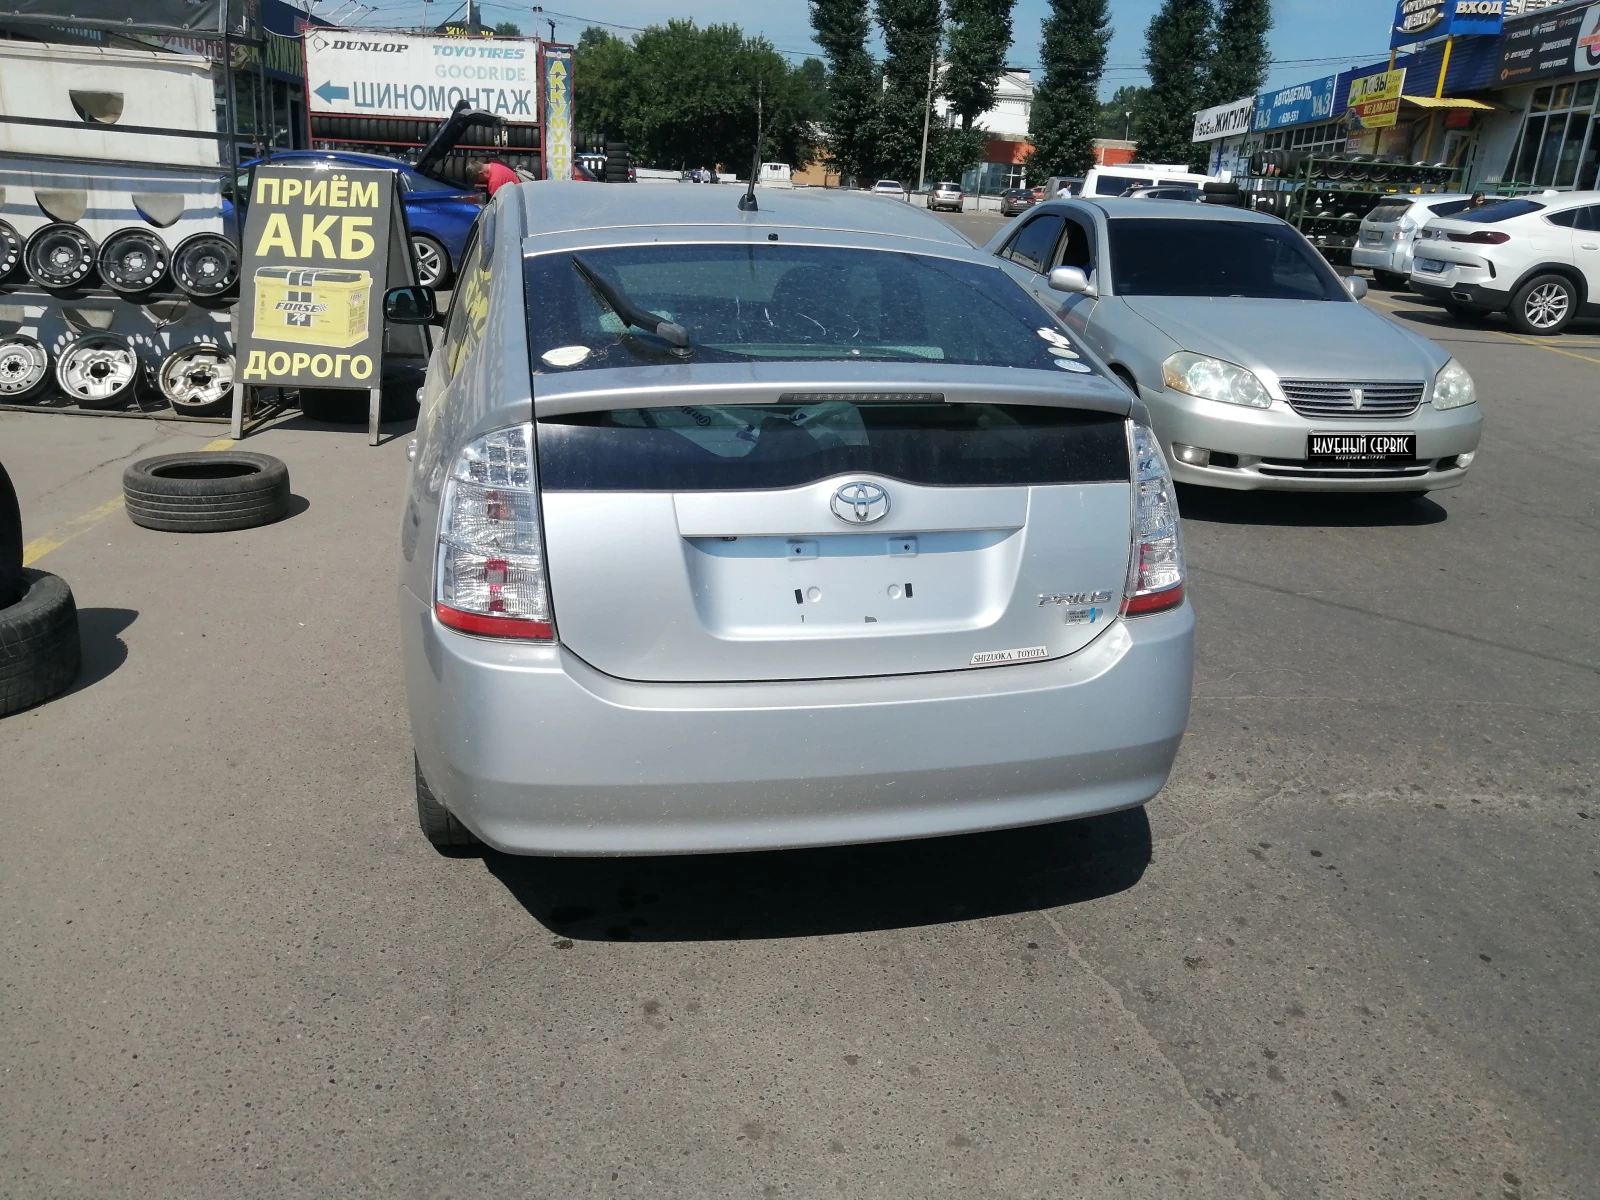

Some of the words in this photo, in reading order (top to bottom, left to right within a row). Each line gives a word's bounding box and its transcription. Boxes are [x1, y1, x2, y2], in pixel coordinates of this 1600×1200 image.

[1455, 1, 1504, 15] ВХОД
[331, 40, 409, 54] DUNLOP
[433, 45, 477, 59] TOYO
[479, 47, 525, 60] TIRES
[354, 81, 531, 115] ШИНОМОНТАЖ
[1273, 86, 1312, 108] АВТОДЕТАЛЬ
[1312, 93, 1331, 117] УАЗ
[1214, 105, 1252, 133] ЖИГУЛИ
[1255, 109, 1271, 129] ГАЗ
[256, 174, 379, 207] ПРИЁМ
[255, 213, 375, 260] АКБ
[275, 302, 318, 313] FORSE
[291, 313, 307, 322] 74
[243, 350, 373, 381] ДОРОГО
[1038, 589, 1113, 607] PRIUS
[974, 652, 1012, 663] SHIZUOKA
[1017, 648, 1045, 659] TOYOTA
